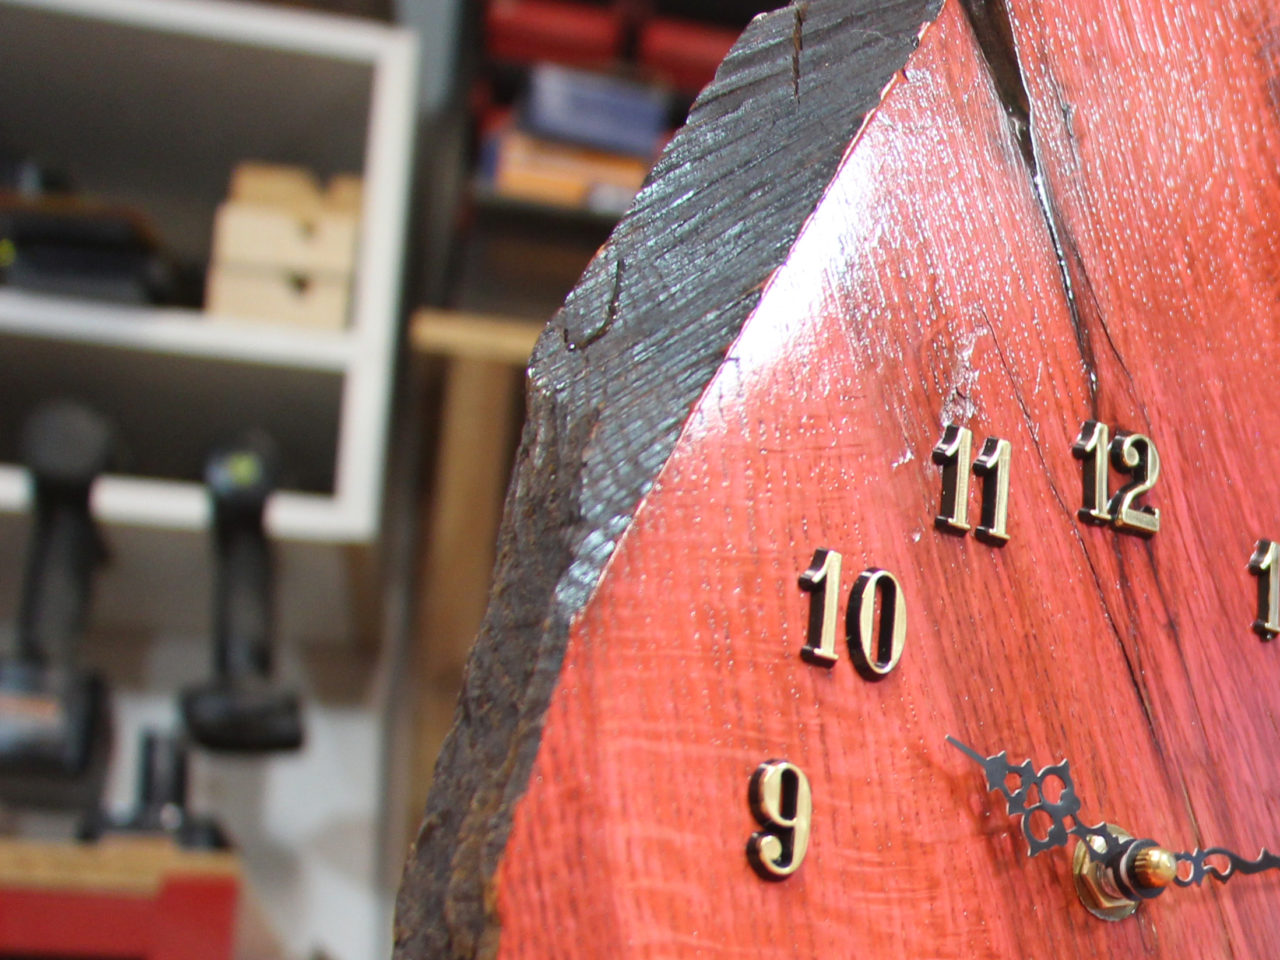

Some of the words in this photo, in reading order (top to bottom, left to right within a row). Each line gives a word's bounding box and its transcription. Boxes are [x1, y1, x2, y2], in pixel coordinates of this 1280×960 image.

[933, 424, 1010, 545] 11
[1073, 421, 1160, 537] 12
[800, 548, 906, 680] 10
[747, 759, 811, 880] 9
